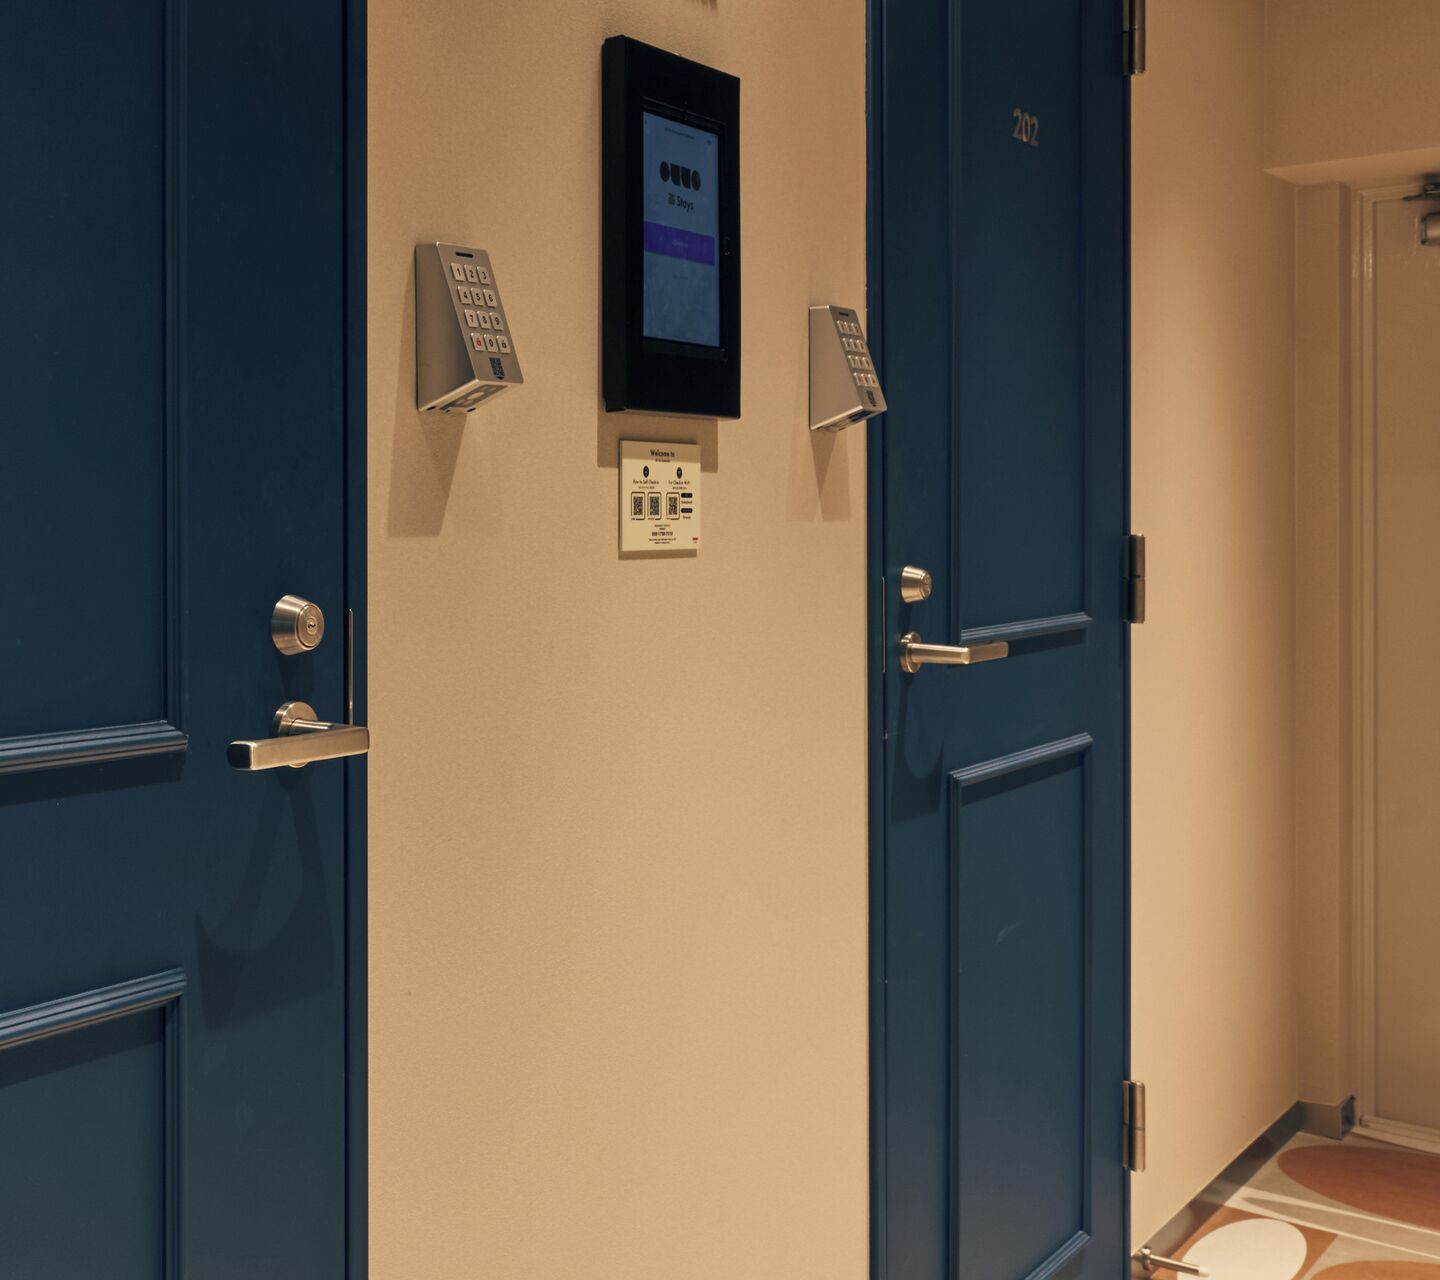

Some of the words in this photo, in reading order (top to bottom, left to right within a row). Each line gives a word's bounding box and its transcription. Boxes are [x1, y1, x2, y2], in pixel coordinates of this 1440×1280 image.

[1012, 107, 1040, 146] 202
[676, 195, 694, 213] Stays
[650, 449, 669, 457] Welcome
